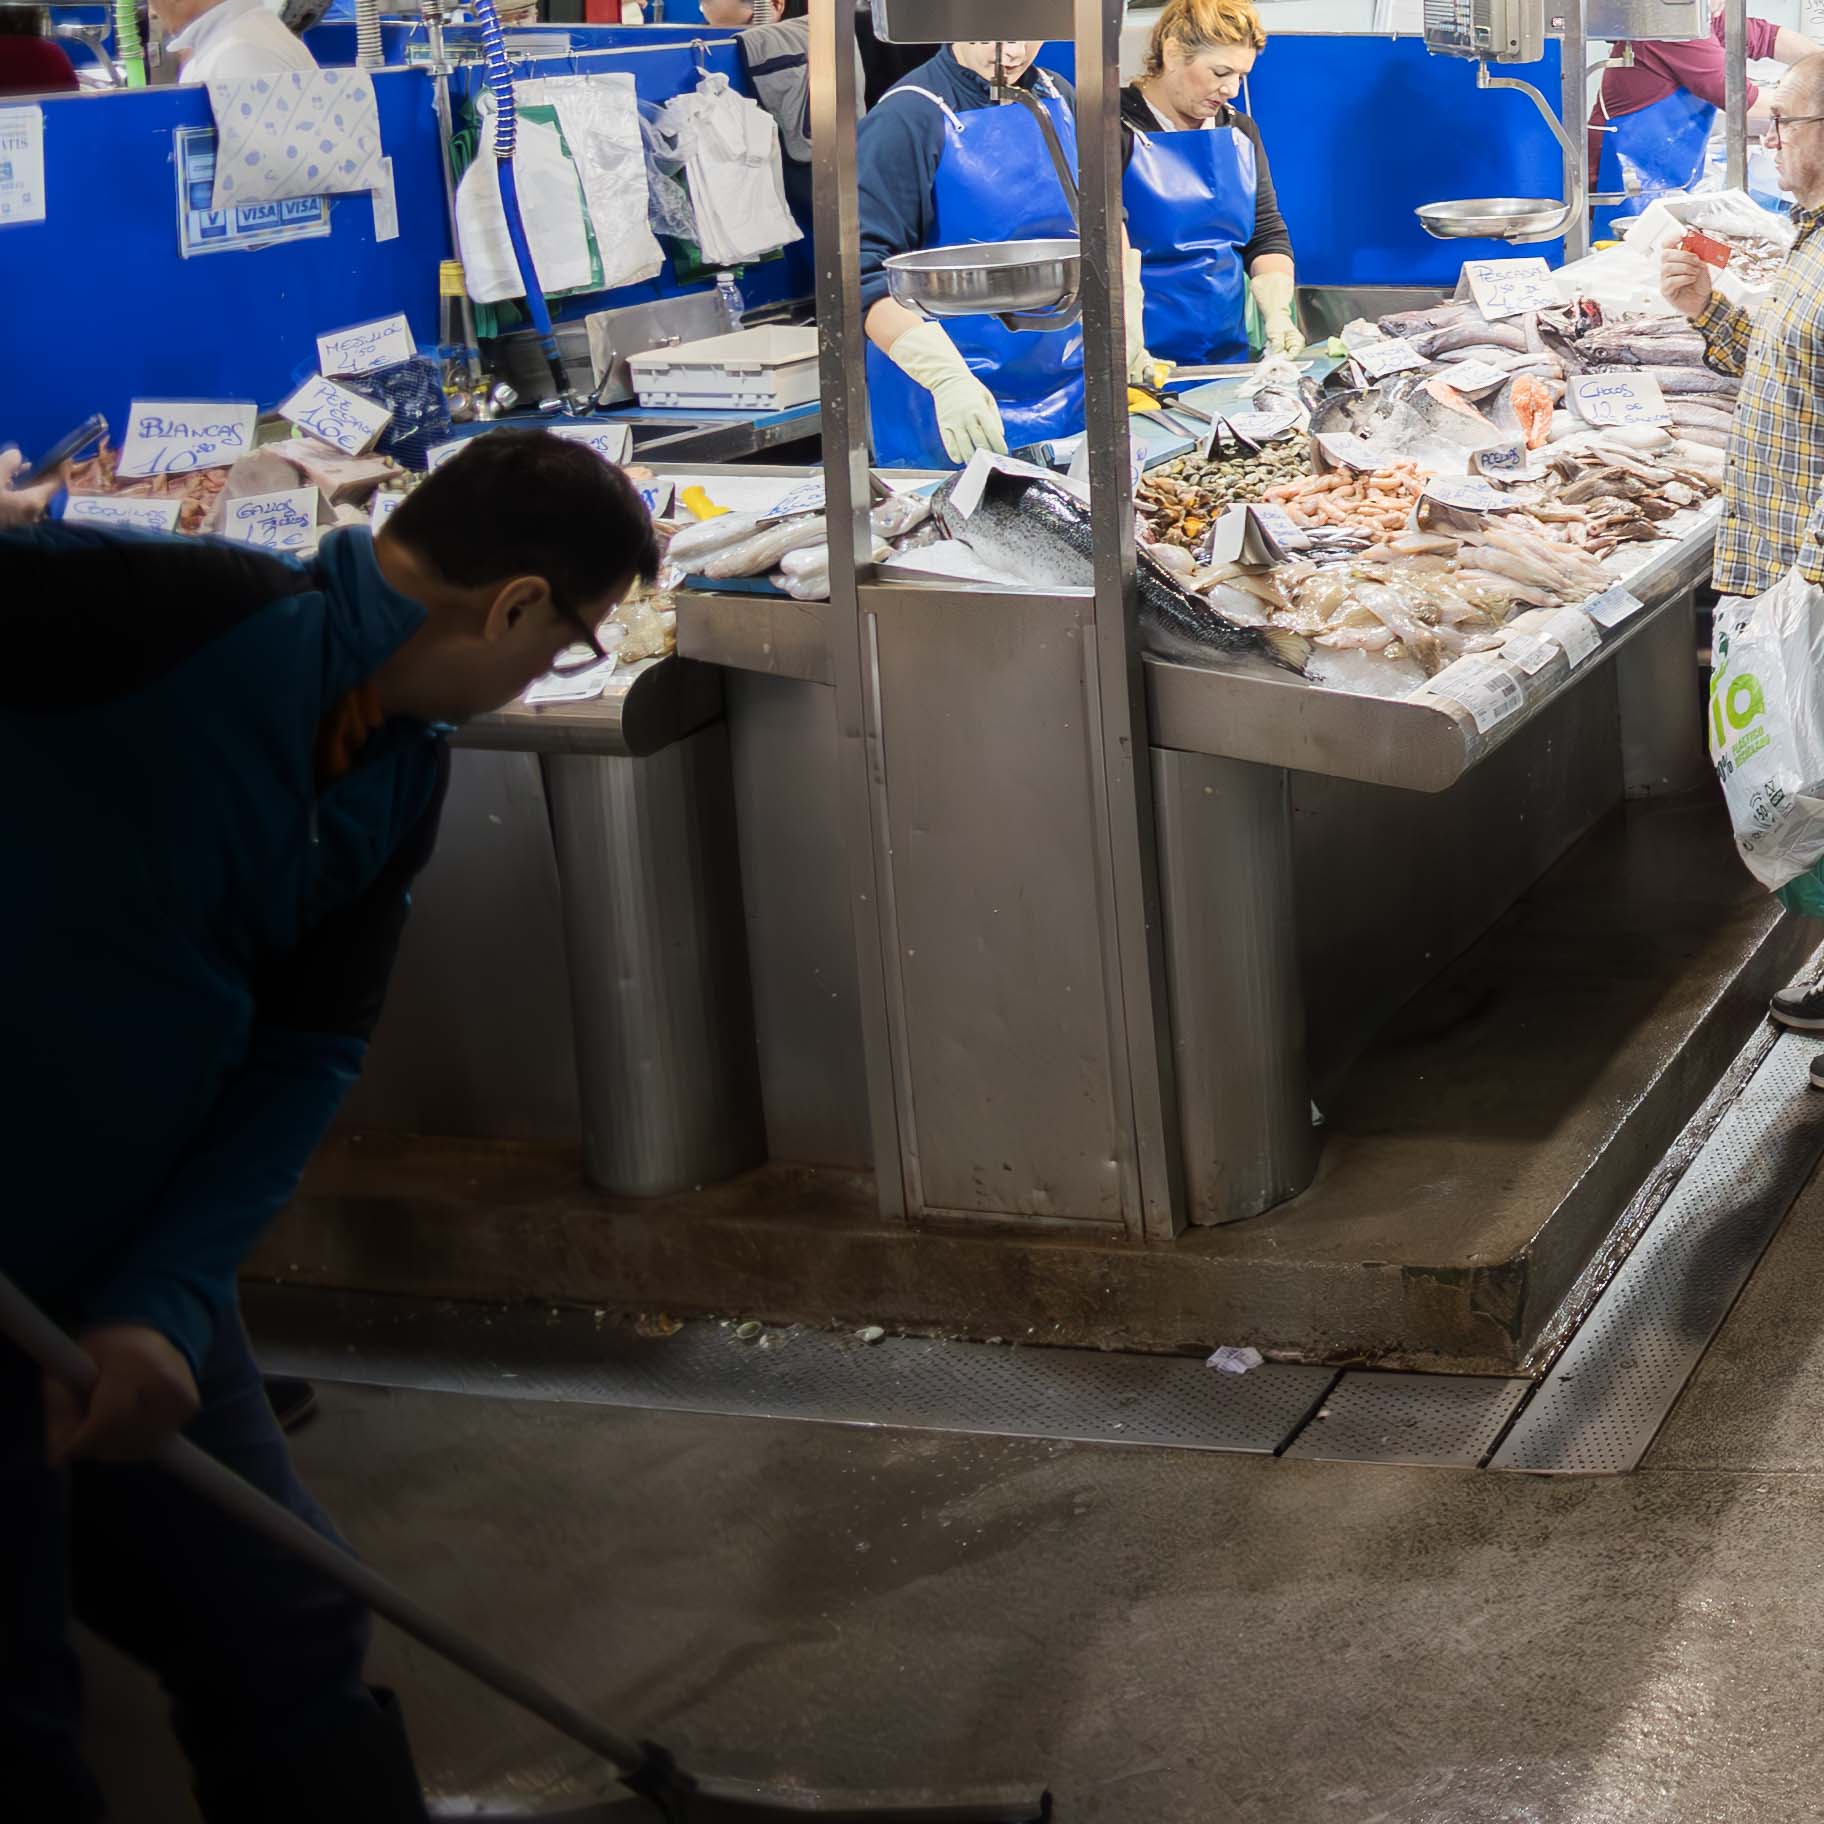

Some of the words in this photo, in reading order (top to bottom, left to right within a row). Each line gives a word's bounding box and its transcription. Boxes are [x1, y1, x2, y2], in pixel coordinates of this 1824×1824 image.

[242, 204, 277, 222] VISA
[286, 197, 319, 215] VISA
[139, 417, 244, 446] BLANCAS
